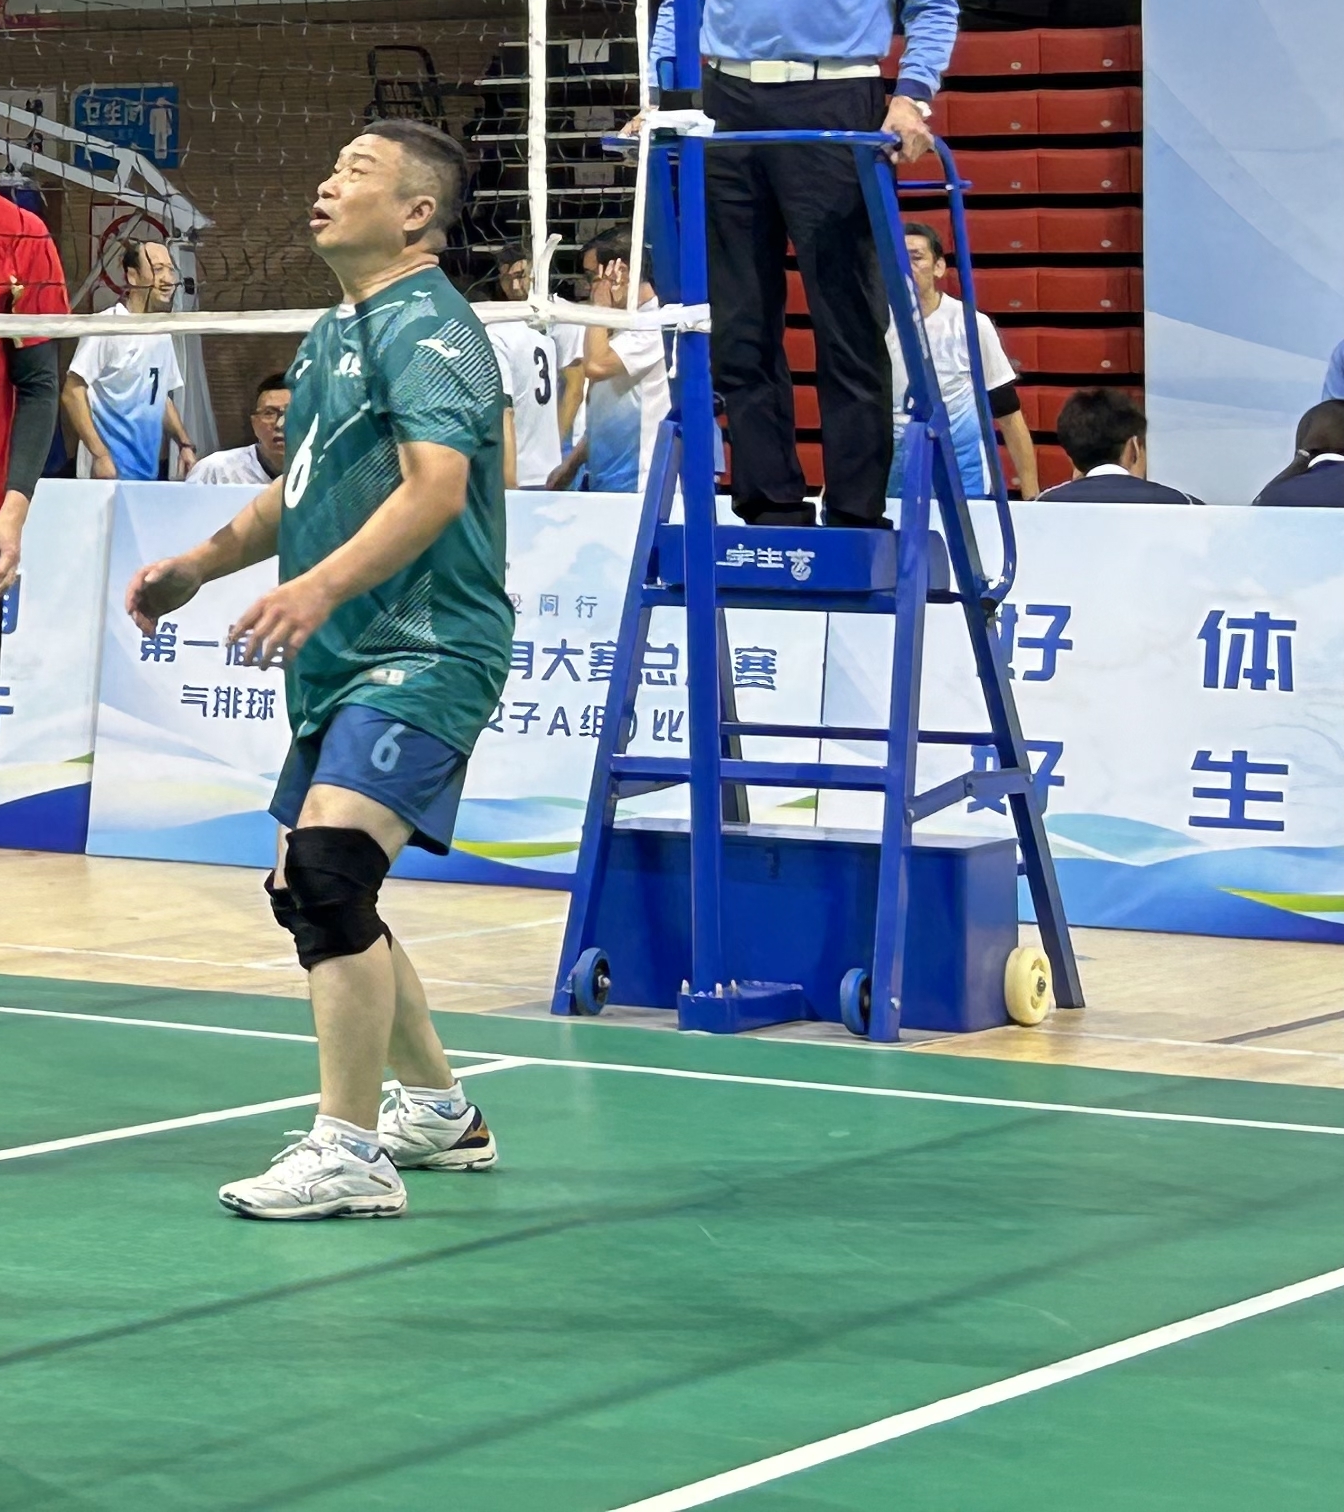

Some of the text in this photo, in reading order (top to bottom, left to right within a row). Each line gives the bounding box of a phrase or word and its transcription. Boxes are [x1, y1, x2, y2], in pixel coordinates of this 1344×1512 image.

[533, 345, 552, 407] 3
[283, 412, 320, 510] 6
[180, 684, 276, 721] 气排球
[370, 721, 404, 773] 6
